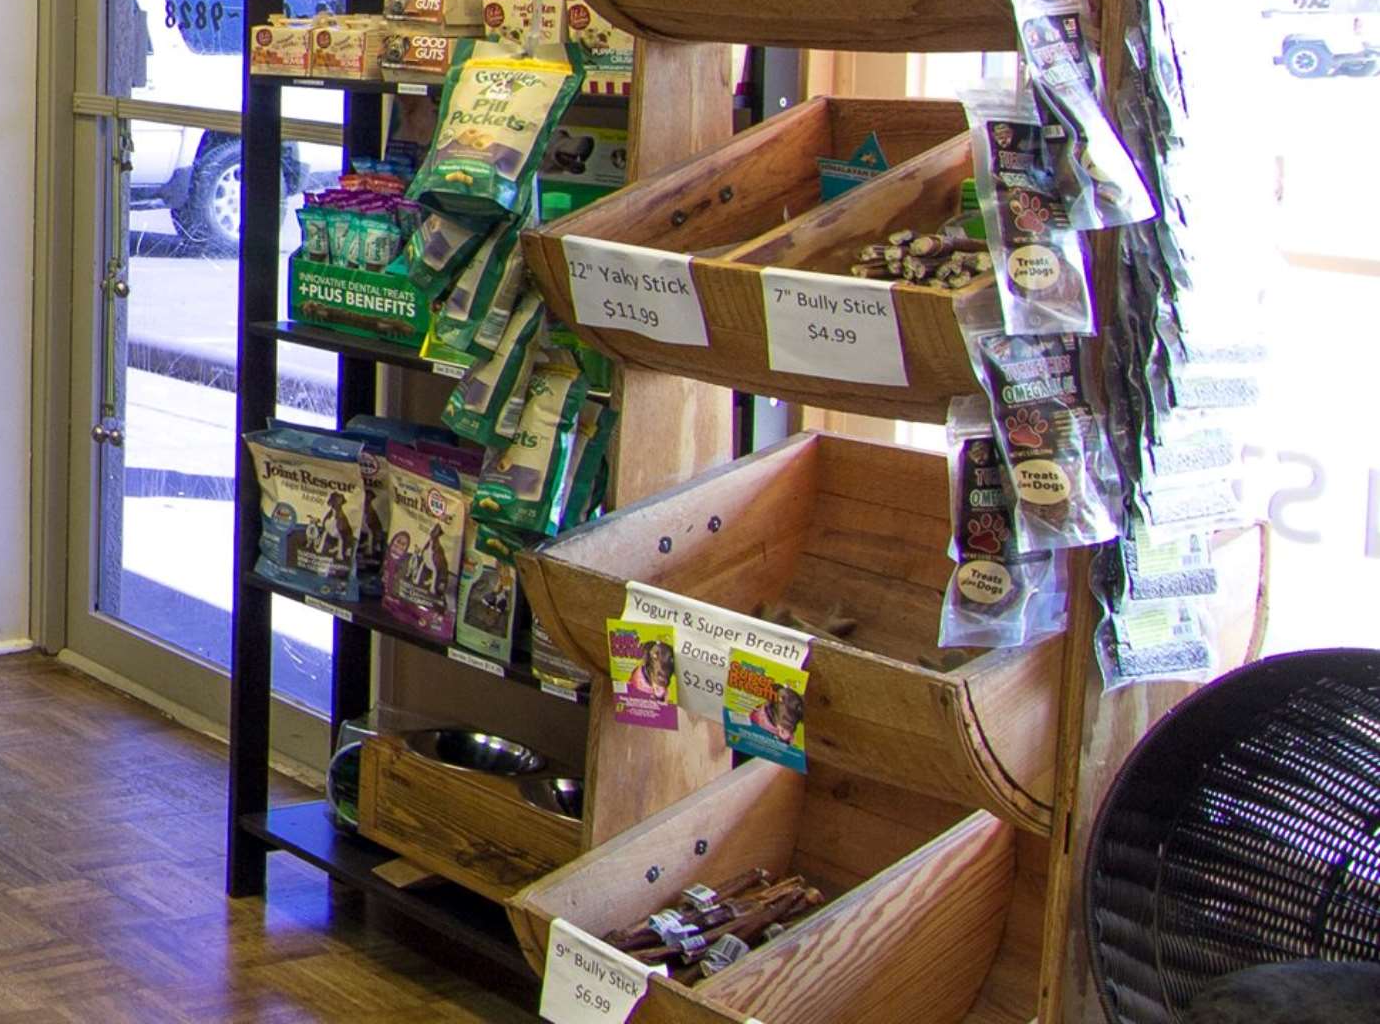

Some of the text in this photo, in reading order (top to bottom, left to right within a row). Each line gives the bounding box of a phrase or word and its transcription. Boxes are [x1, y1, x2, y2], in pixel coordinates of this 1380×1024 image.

[415, 0, 442, 11] GUTS
[411, 36, 447, 48] GOOD
[415, 49, 445, 61] GUTS
[472, 97, 510, 113] Pill
[448, 110, 526, 132] Pockets
[1016, 255, 1050, 269] Treats
[569, 260, 690, 297] 12" Yaky Stick
[299, 282, 416, 318] +PLUS BENEFITS
[348, 280, 382, 294] DENTAL
[382, 287, 416, 302] TREATS
[603, 299, 660, 328] $11.99
[773, 287, 889, 318] 7" Bully Stick
[807, 323, 858, 345] $4.99
[261, 460, 357, 494] Joint Rescue
[1020, 470, 1059, 482] Treats
[1032, 480, 1065, 492] Dogs
[971, 569, 1004, 586] Treats
[976, 578, 1004, 595] Dogs
[633, 594, 801, 662] Yogurt & Super Breath
[681, 641, 728, 668] Bones
[683, 670, 724, 697] $2.99
[555, 942, 640, 998] 9" Bully Stick
[574, 983, 611, 1014] $6.99
